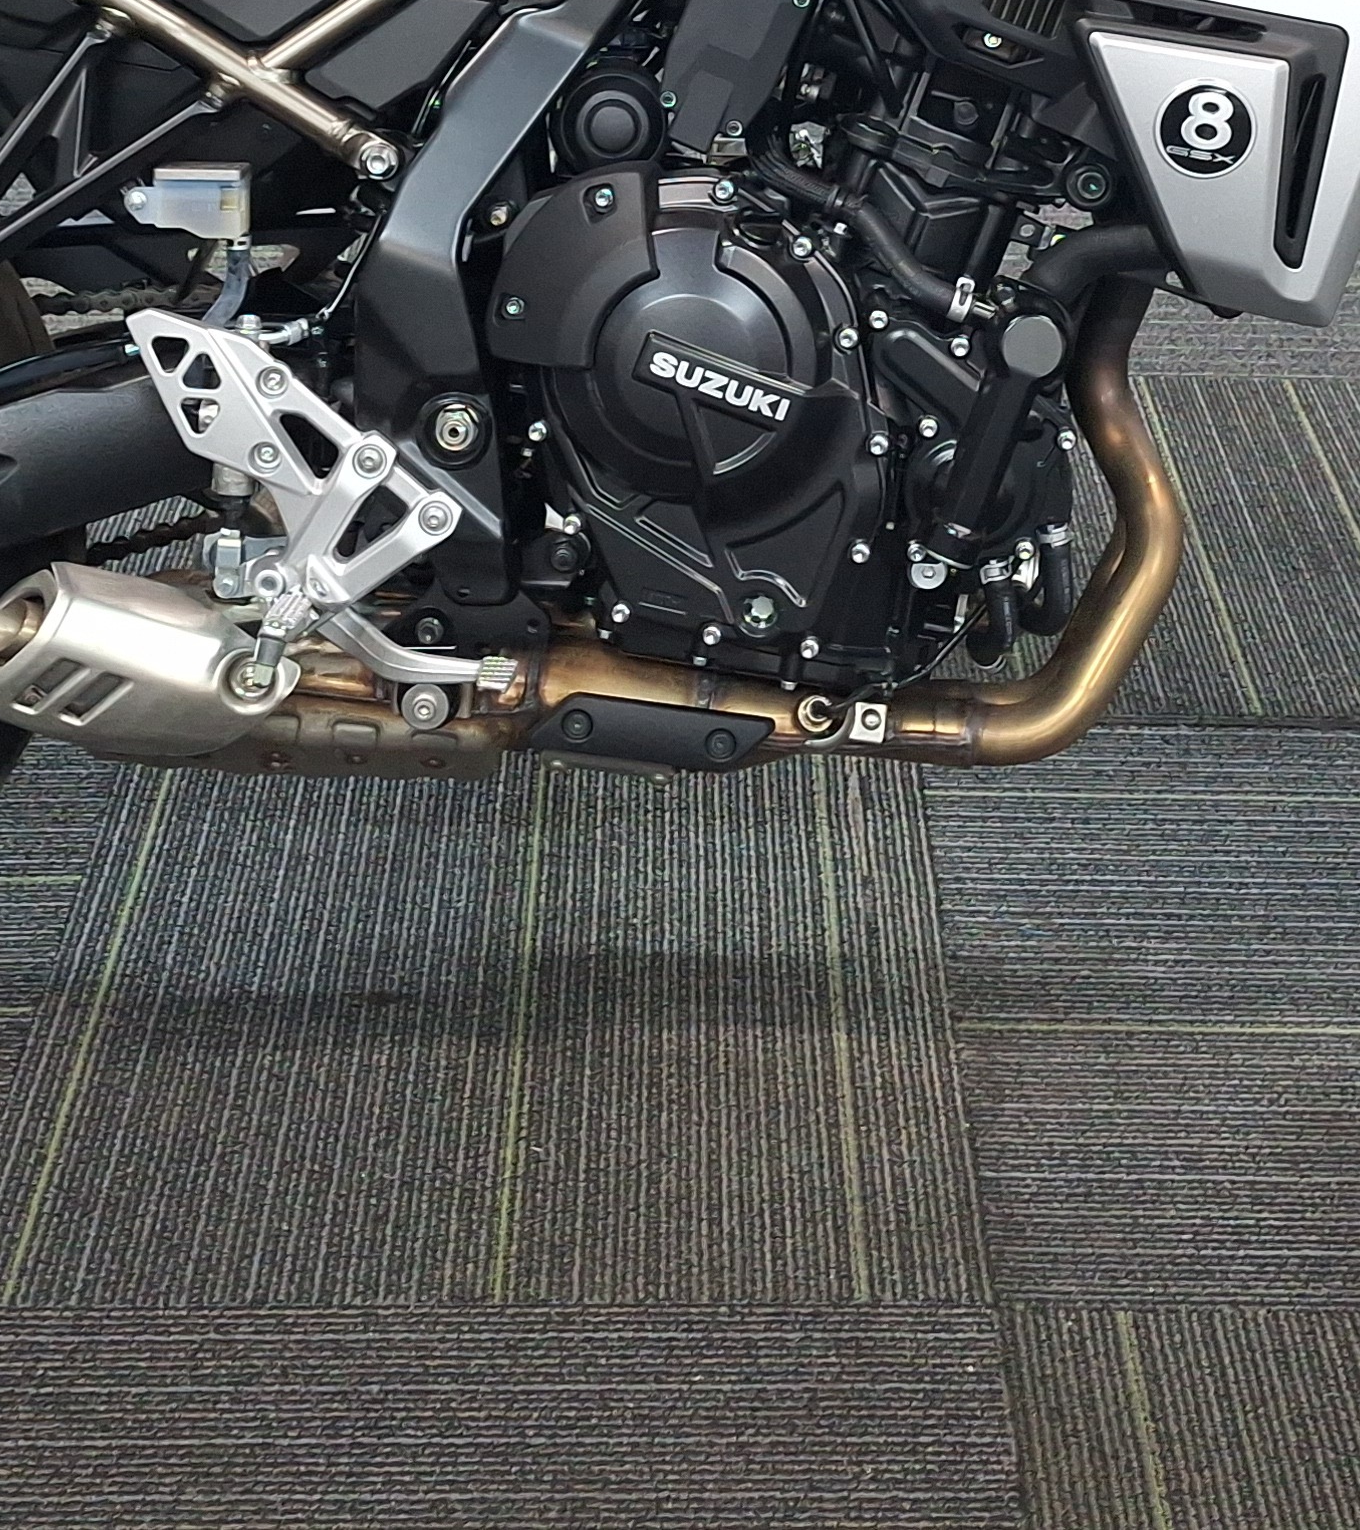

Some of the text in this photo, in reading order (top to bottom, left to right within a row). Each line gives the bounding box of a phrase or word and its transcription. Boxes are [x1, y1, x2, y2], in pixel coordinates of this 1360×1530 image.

[1180, 91, 1235, 151] 8
[1166, 145, 1236, 164] GSX
[649, 351, 791, 422] SUZUKI
